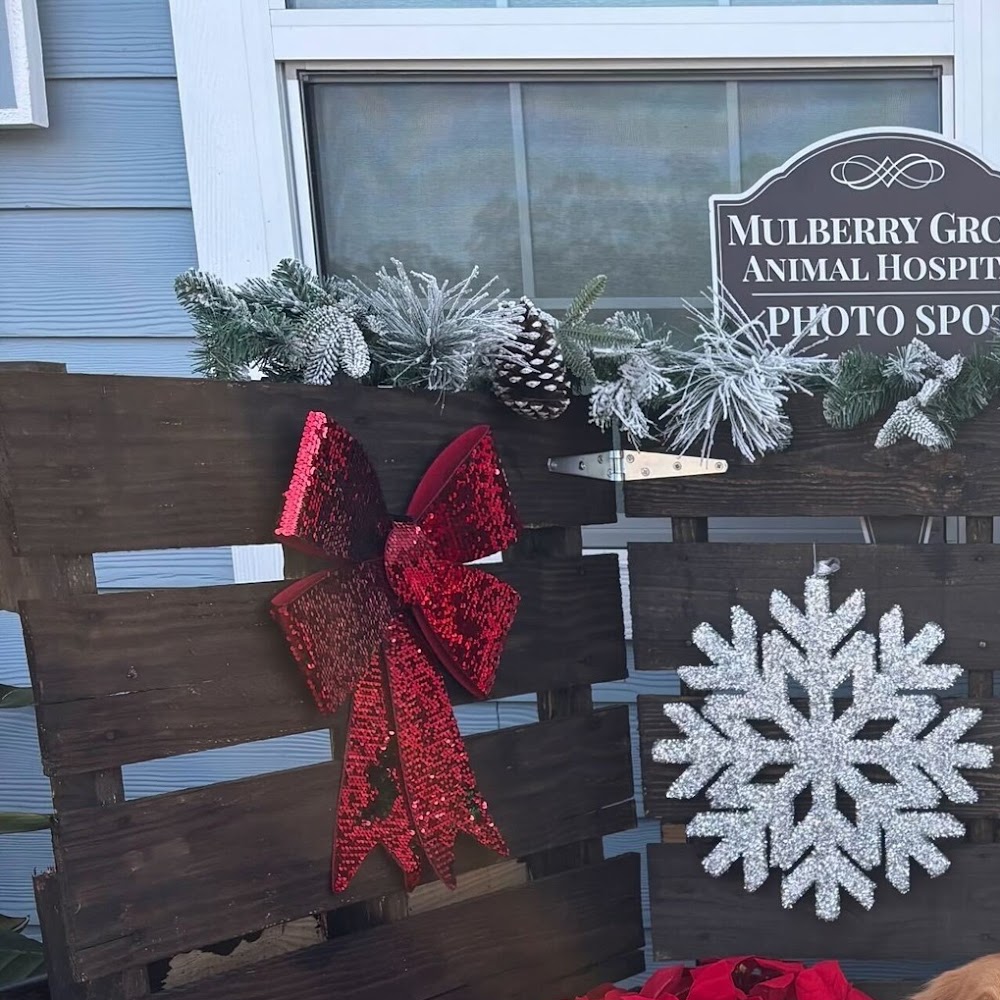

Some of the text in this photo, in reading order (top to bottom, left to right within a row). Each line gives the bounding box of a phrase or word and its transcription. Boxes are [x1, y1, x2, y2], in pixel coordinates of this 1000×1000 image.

[727, 213, 923, 246] MULBERRY
[742, 254, 869, 282] ANIMAL
[766, 304, 905, 337] PHOTO
